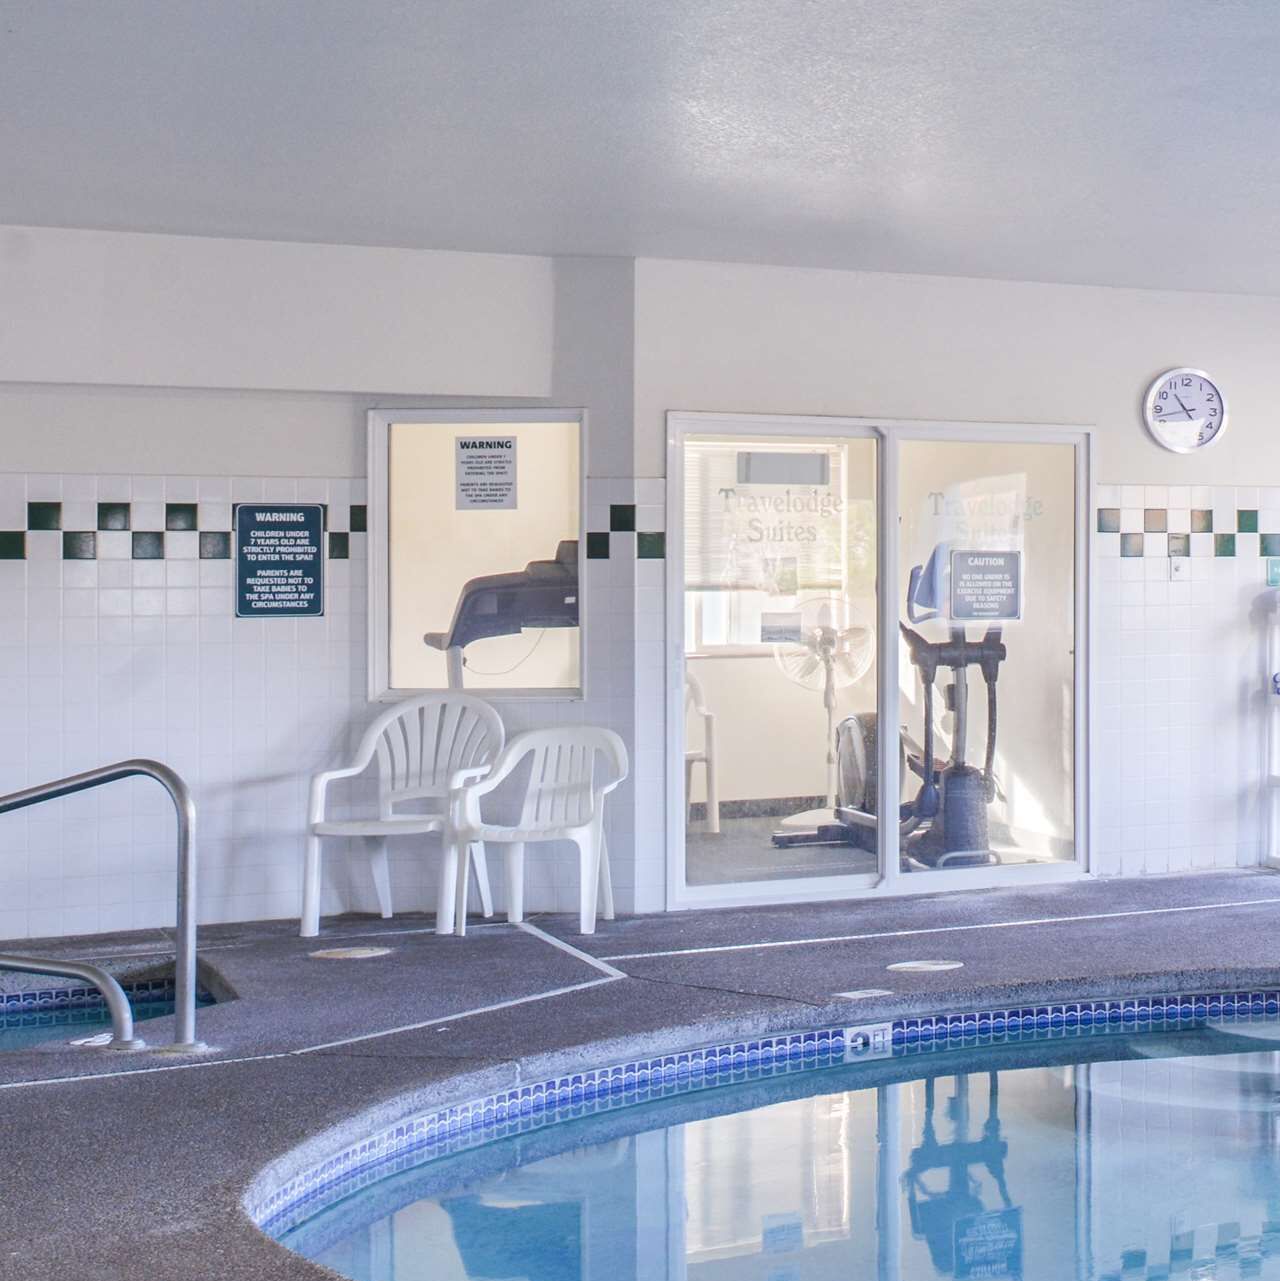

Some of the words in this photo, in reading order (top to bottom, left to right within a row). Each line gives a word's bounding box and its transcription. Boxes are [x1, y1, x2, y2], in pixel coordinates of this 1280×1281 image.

[1170, 381, 1176, 390] 11
[1182, 378, 1192, 387] 12
[1159, 391, 1168, 400] 10
[1206, 393, 1214, 401] 2
[1154, 405, 1163, 414] 9
[1209, 408, 1217, 417] 3
[460, 441, 512, 449] WARNING
[718, 488, 843, 518] Travelodge
[255, 513, 305, 522] WARNING
[747, 518, 817, 542] Suites
[968, 557, 1005, 566] CAUTION
